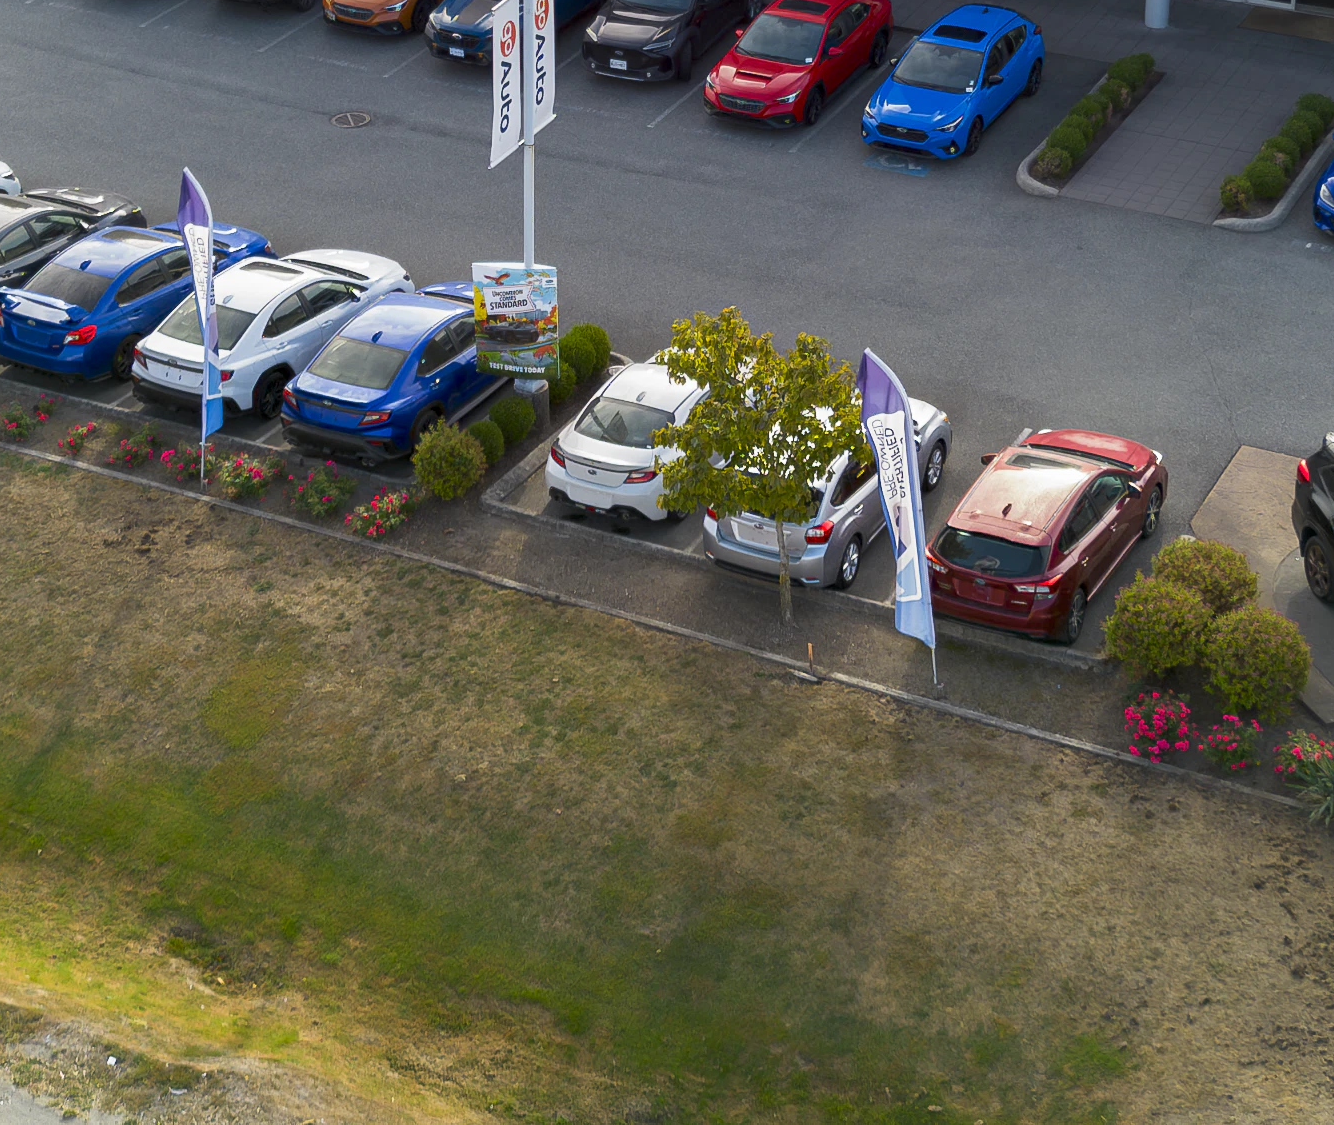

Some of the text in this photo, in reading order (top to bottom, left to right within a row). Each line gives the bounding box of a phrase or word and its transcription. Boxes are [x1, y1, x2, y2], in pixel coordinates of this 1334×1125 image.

[535, 34, 547, 106] Auto
[500, 61, 512, 134] Auto
[490, 299, 528, 311] STANDARD
[489, 362, 504, 370] TEST
[524, 366, 546, 374] TODAY
